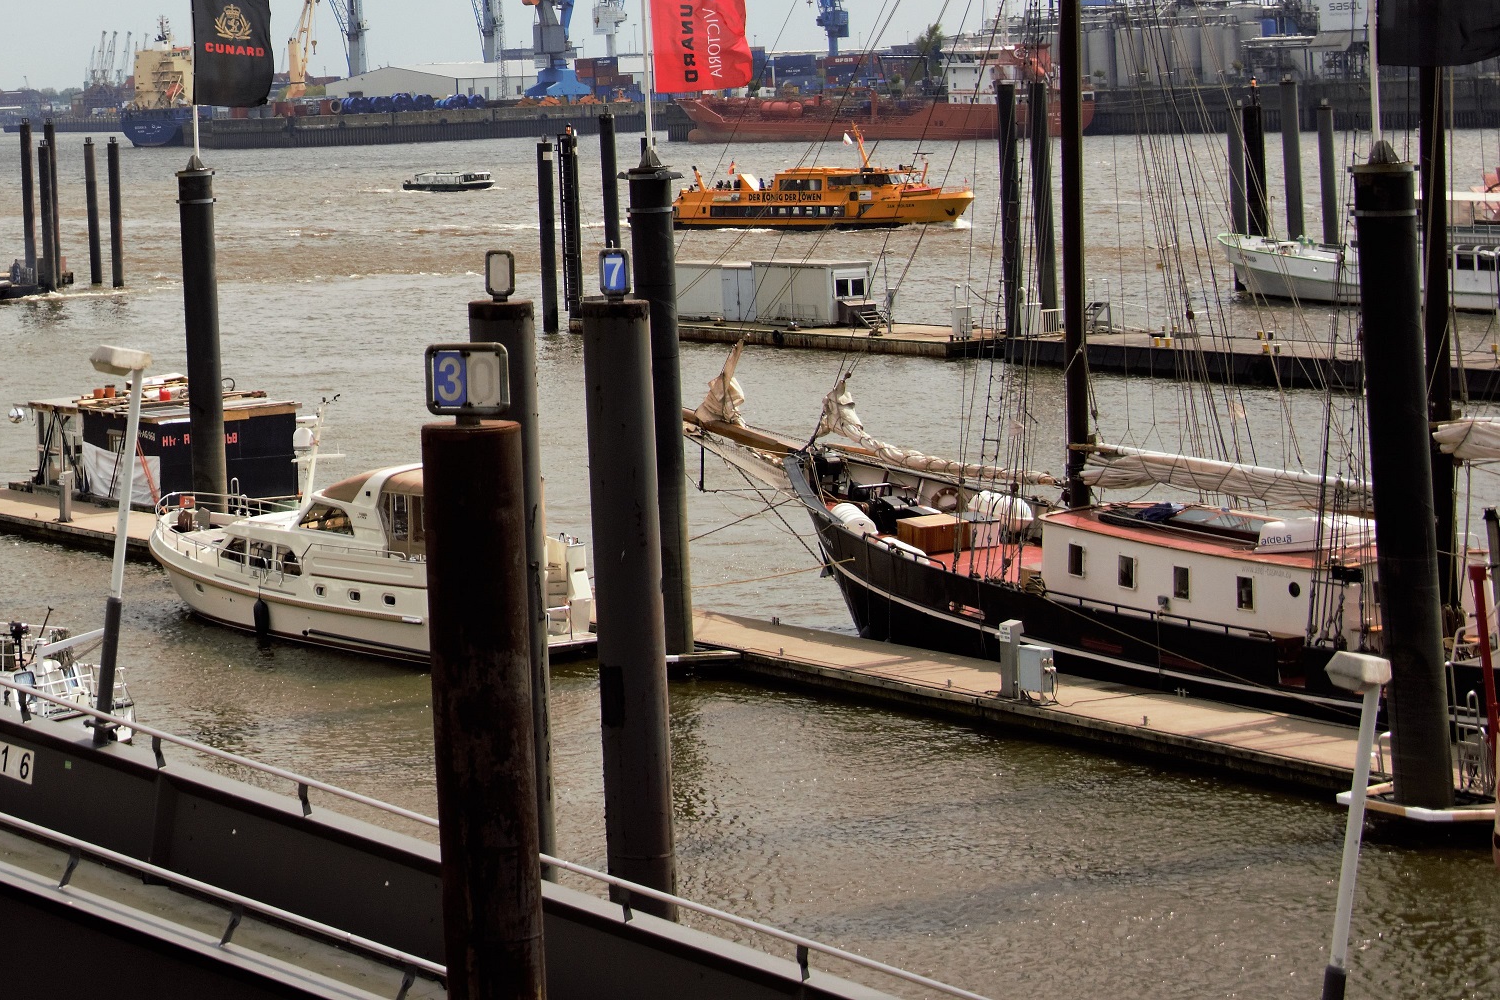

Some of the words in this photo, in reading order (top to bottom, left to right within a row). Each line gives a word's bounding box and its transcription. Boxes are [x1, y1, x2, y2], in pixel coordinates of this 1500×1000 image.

[205, 42, 265, 57] CUNARD
[748, 193, 761, 201] DER
[761, 192, 783, 202] KÖNIG
[784, 194, 797, 202] DER
[797, 191, 822, 202] LÖWEN
[605, 257, 623, 287] 7
[1261, 534, 1292, 546] grapje
